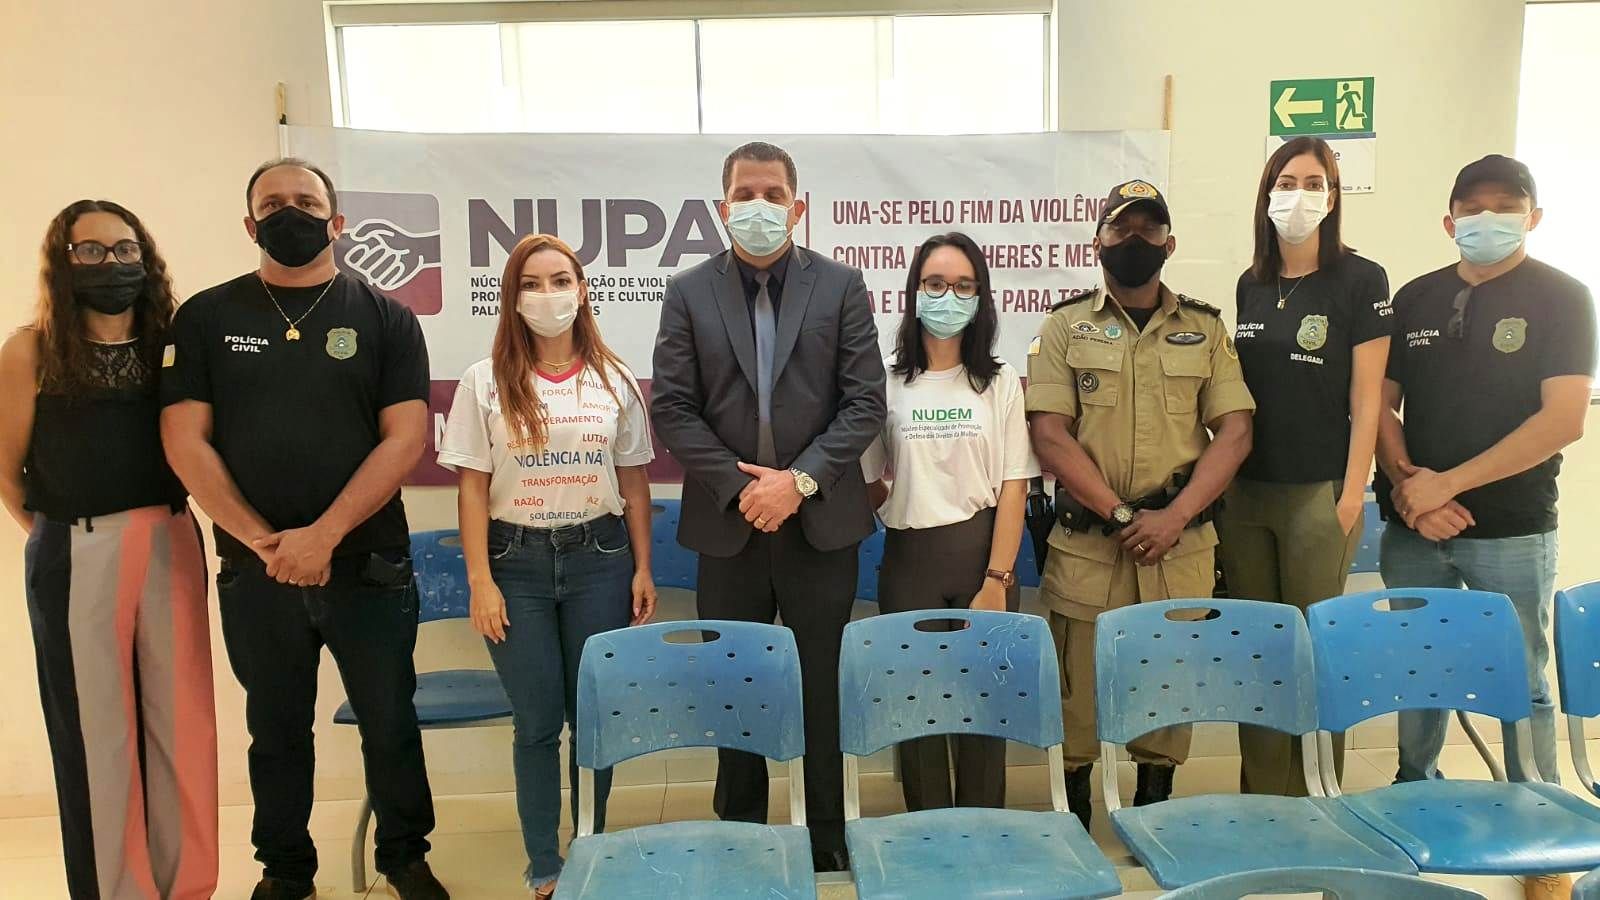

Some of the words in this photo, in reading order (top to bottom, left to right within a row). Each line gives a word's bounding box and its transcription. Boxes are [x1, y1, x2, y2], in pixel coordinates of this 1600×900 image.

[833, 201, 902, 225] UNA-SE
[908, 200, 954, 224] PELO
[960, 200, 992, 224] FIM
[1000, 199, 1025, 224] DA
[468, 199, 732, 267] NUPA
[833, 246, 906, 269] CONTRA
[982, 244, 1042, 268] HERES
[1048, 244, 1059, 267] E
[471, 275, 502, 287] NÚCL
[619, 278, 635, 287] DE
[589, 292, 605, 301] DE
[608, 292, 615, 301] E
[618, 292, 664, 301] CULTUR
[882, 290, 892, 313] E
[1003, 289, 1052, 312] PARA
[1237, 322, 1264, 330] OLÍCIA
[224, 335, 269, 346] POLÍCIA
[1407, 328, 1440, 341] POLÍCIA
[231, 344, 261, 352] CIVIL
[1409, 338, 1431, 347] CIVIL
[1290, 353, 1324, 365] DELEGADA
[542, 388, 573, 398] FORÇA
[912, 408, 972, 421] NUDEM
[514, 449, 581, 468] VIOLÊNCIA
[585, 449, 604, 467] NÃ
[521, 473, 598, 487] TRANSFORMAÇÃO
[514, 496, 544, 507] RAZÃO
[586, 496, 599, 505] AZ
